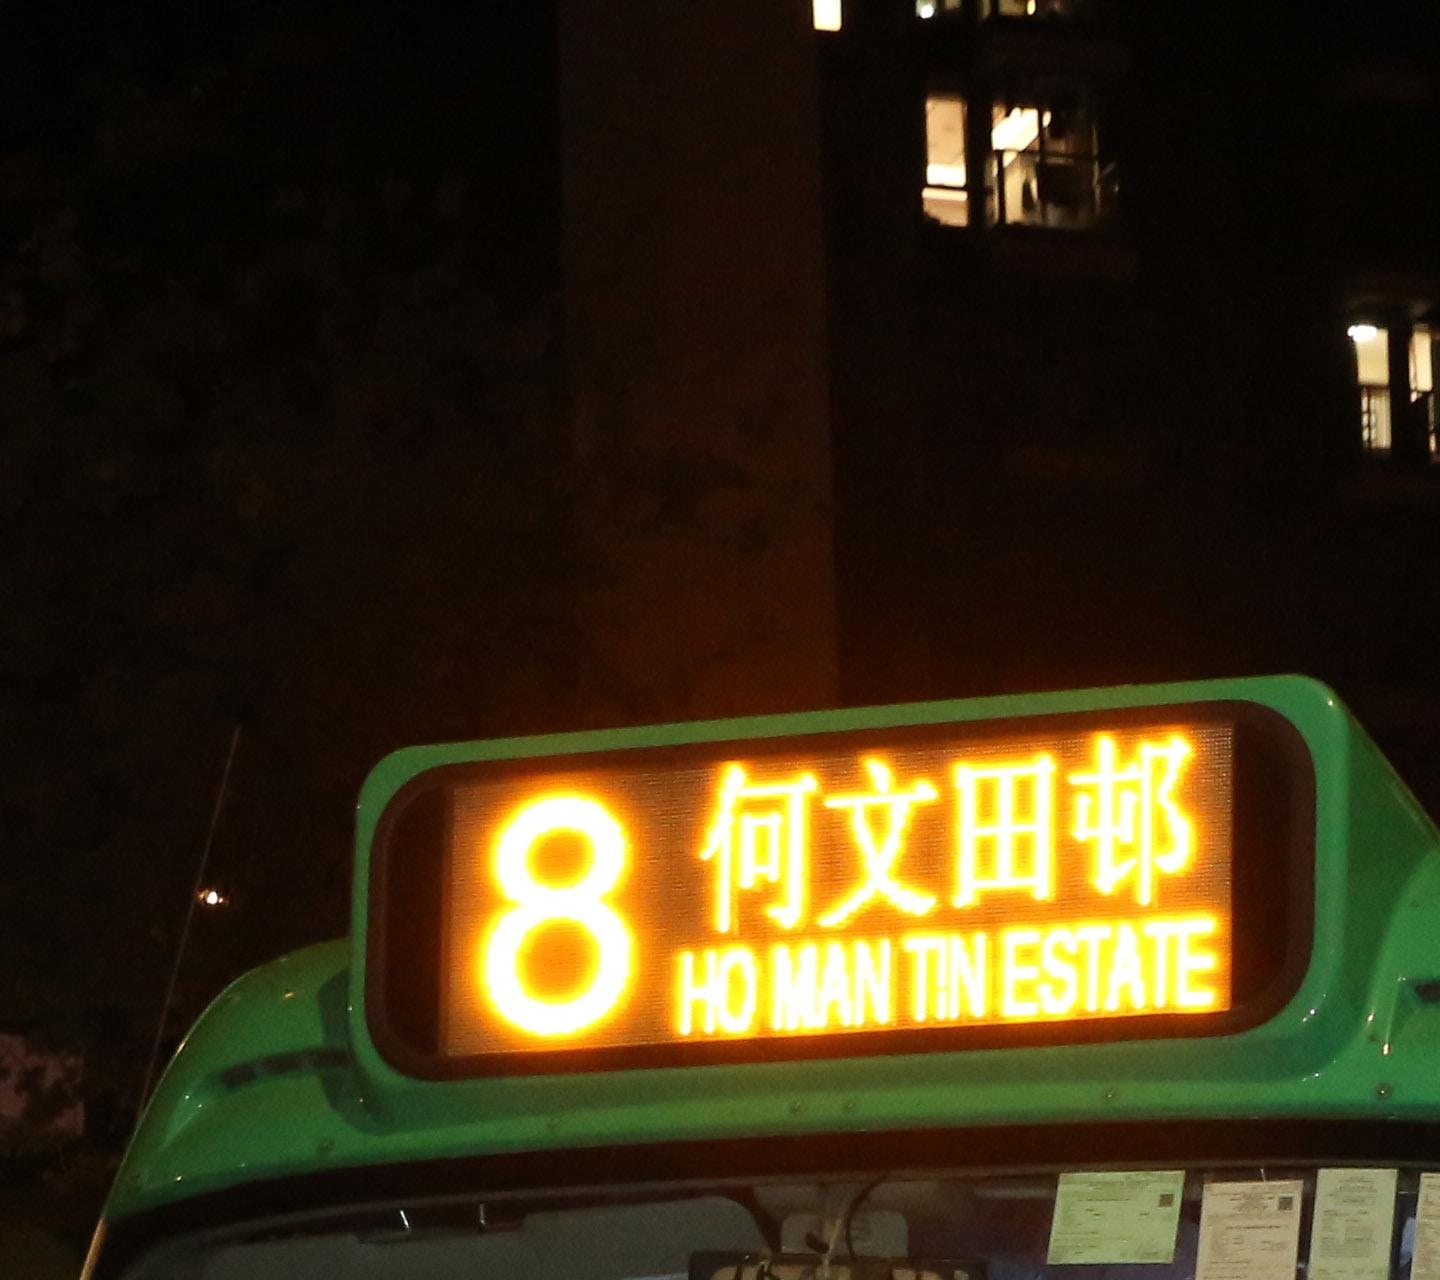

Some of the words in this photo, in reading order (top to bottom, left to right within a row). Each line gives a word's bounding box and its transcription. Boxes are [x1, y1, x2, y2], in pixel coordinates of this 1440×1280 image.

[480, 791, 637, 1038] 8
[699, 732, 1197, 934] 何文田邨
[674, 943, 758, 1037] HO
[766, 932, 894, 1033] MAN
[901, 928, 986, 1022] TIN
[989, 915, 1218, 1020] ESTATE
